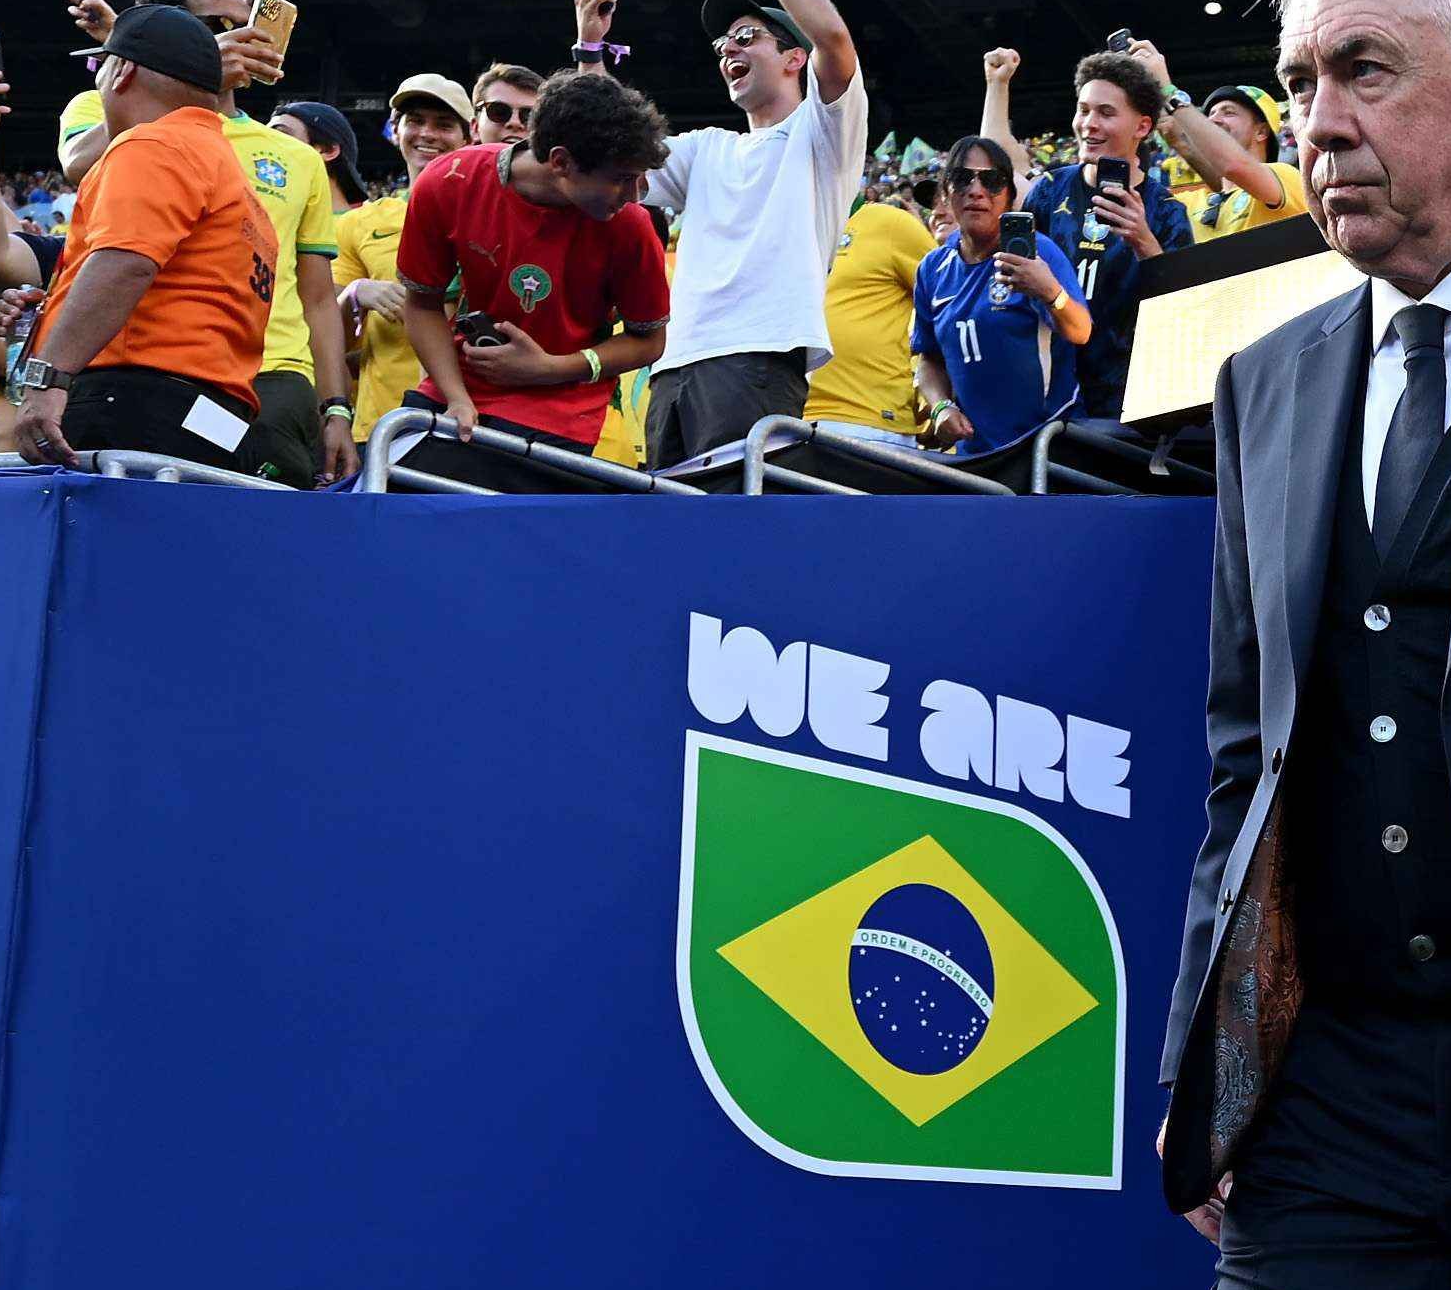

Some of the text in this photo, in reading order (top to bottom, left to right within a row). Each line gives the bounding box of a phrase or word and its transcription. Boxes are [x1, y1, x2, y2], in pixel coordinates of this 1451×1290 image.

[955, 318, 983, 364] 11
[687, 610, 891, 762] WE
[860, 931, 989, 1008] ORDEM E PROGRESSO
